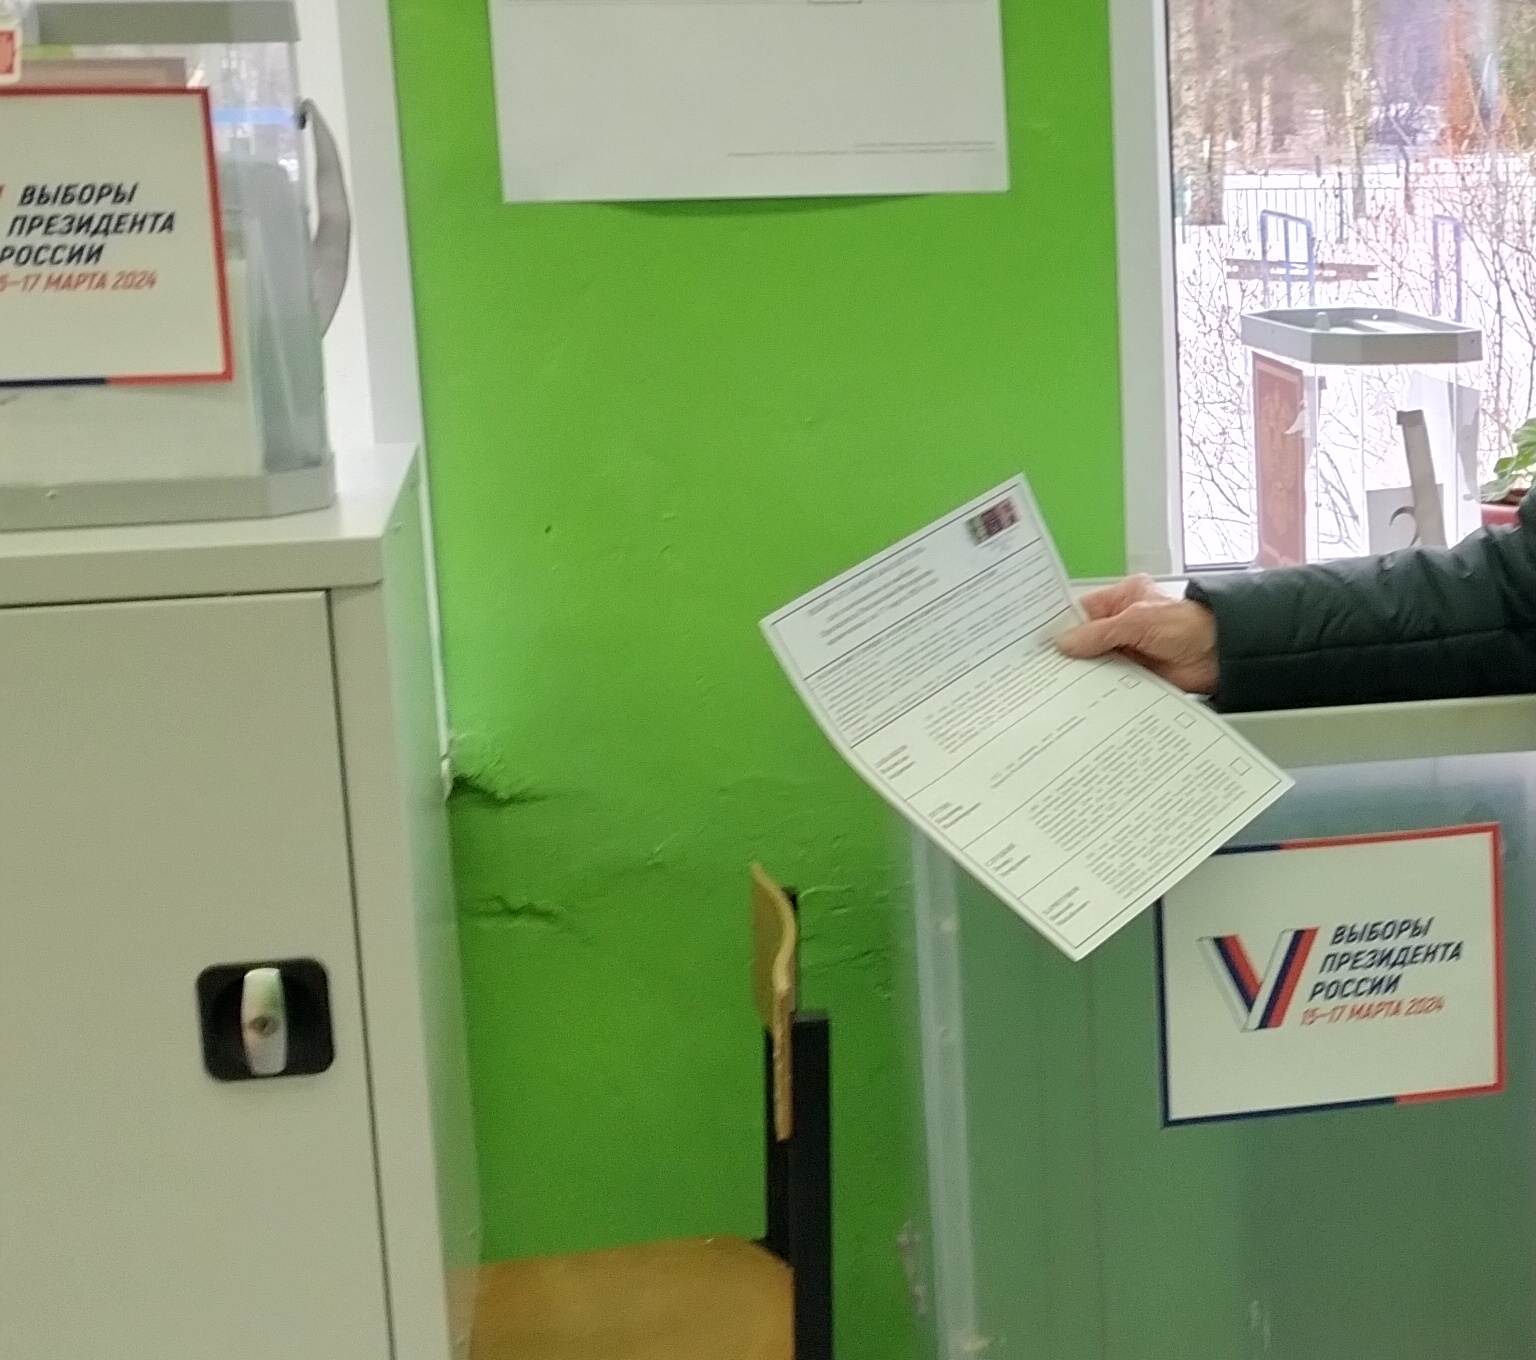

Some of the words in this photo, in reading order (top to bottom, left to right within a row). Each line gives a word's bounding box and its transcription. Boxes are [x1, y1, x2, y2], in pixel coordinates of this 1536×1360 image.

[18, 181, 139, 206] ВЫБОРЫ
[7, 211, 175, 238] ПРЕЗИДЕНТА
[0, 243, 105, 266] РОССИИ
[44, 271, 108, 292] МАРТА
[112, 269, 157, 290] 2024
[1329, 916, 1435, 946] ВЫБОРЫ
[1318, 940, 1463, 974] ПРЕЗИДЕНТА
[1307, 973, 1402, 1002] РОССИИ
[1347, 999, 1400, 1022] МАРТА
[1403, 995, 1445, 1017] 2024
